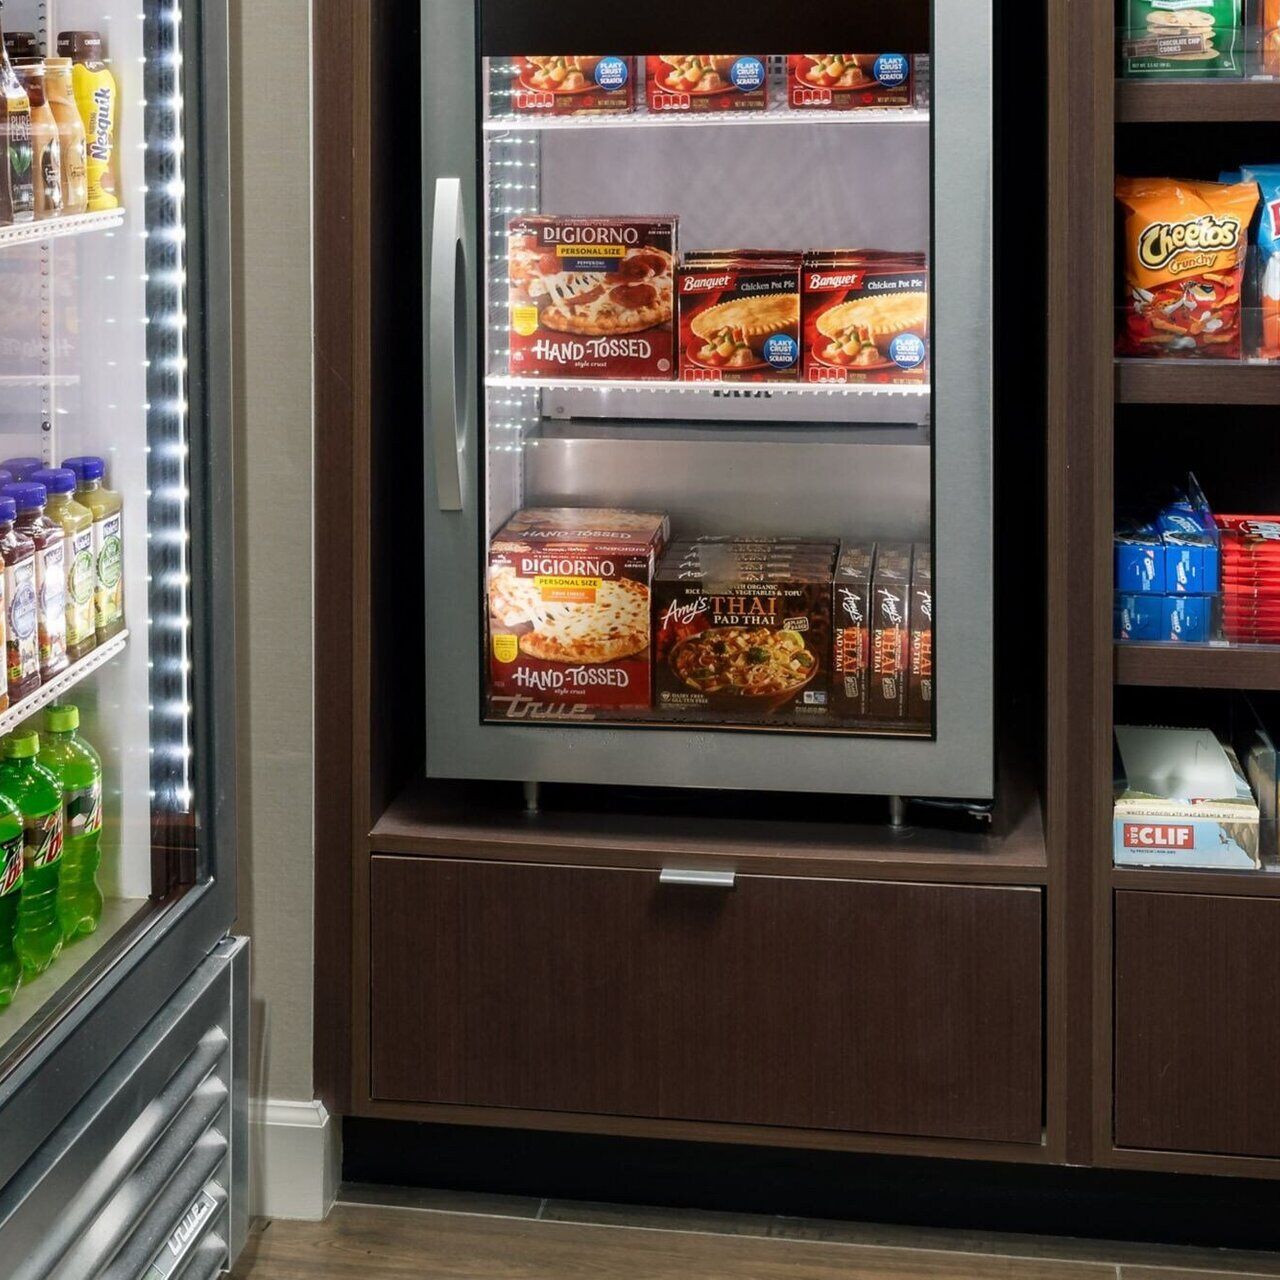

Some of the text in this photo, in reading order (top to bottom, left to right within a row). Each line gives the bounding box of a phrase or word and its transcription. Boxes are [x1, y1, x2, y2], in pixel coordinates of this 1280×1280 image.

[1159, 45, 1182, 53] COOKIES
[91, 87, 111, 161] Nesquik
[543, 227, 639, 244] DIGIORNO
[1139, 216, 1240, 269] Cheetos
[605, 247, 621, 255] SIZE
[1170, 254, 1217, 275] Crunchy
[684, 275, 731, 291] Banquet
[740, 280, 795, 292] Chicken Pot Pie
[810, 274, 858, 289] Banquet
[867, 279, 922, 291] Chicken Pot Pie
[534, 337, 651, 364] HAND-TOSSED
[522, 559, 615, 576] DIGIORNO
[661, 596, 710, 630] Amy's
[710, 596, 776, 615] THAI
[714, 616, 774, 625] PAD THAI
[512, 667, 629, 691] HAND-TOSSED
[491, 696, 596, 719] true
[1139, 828, 1189, 846] CLIF
